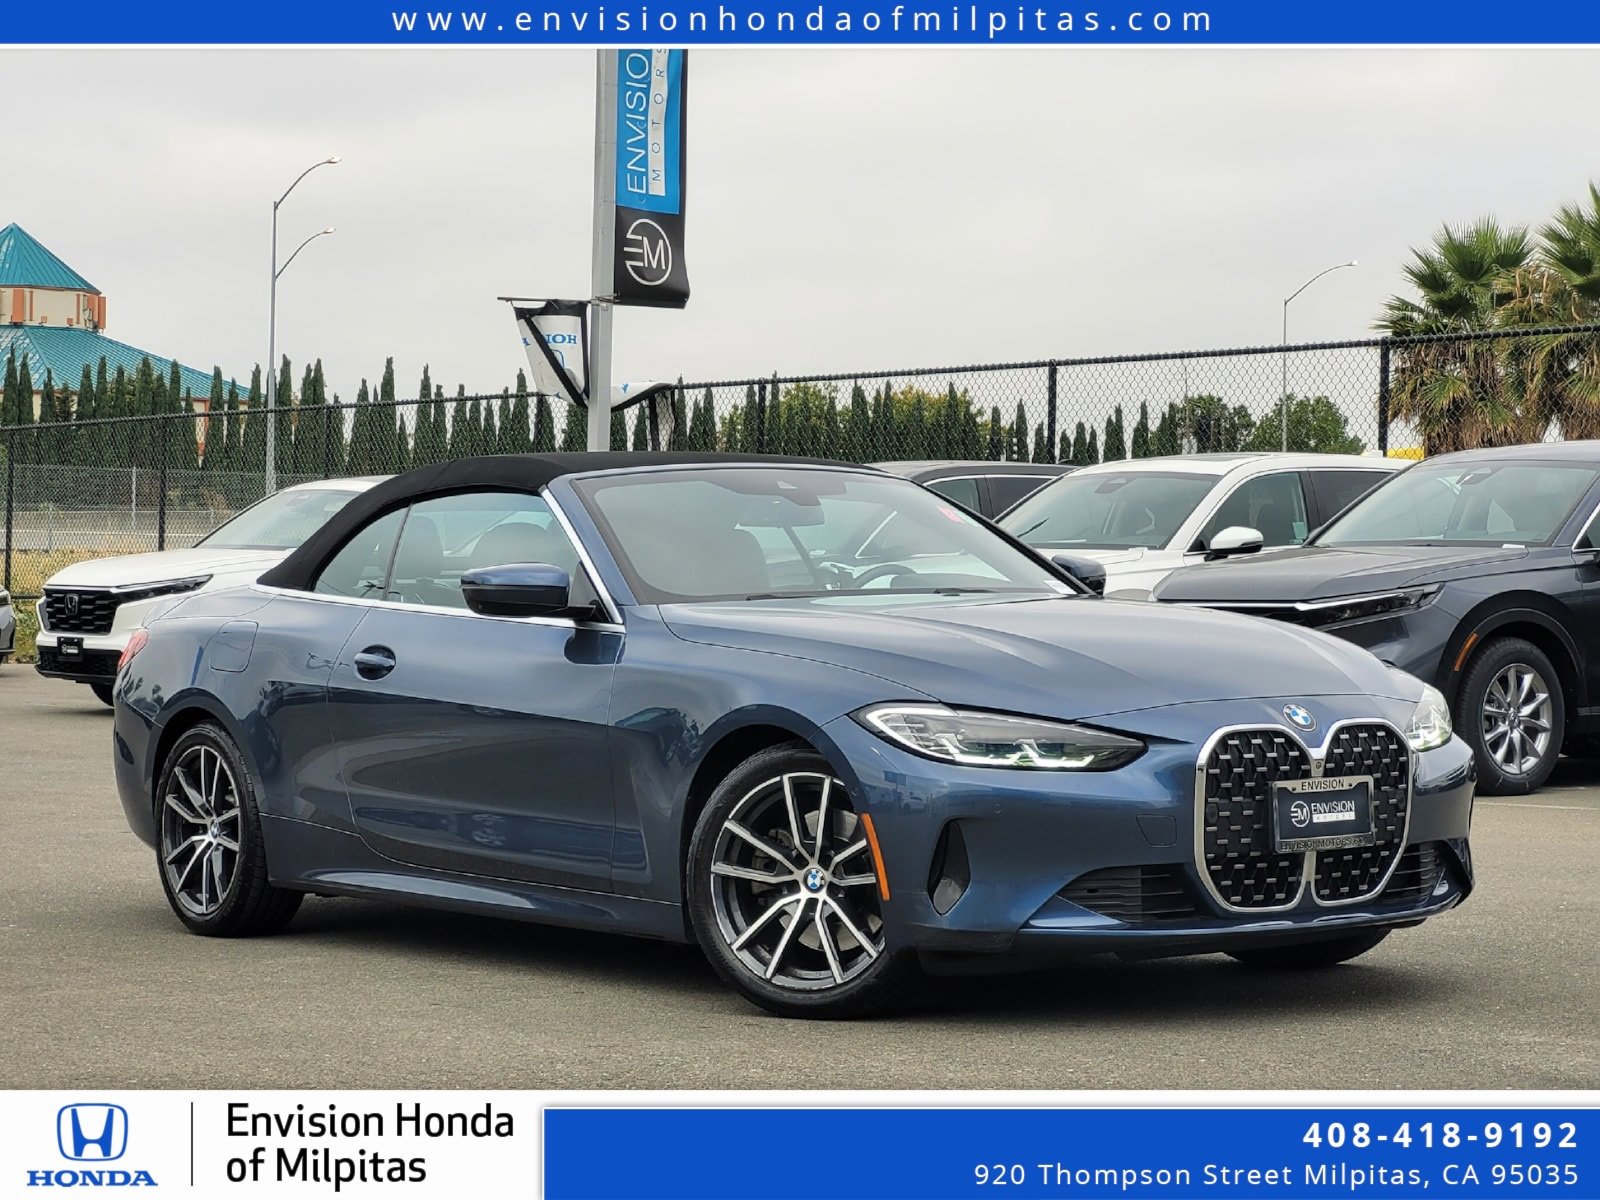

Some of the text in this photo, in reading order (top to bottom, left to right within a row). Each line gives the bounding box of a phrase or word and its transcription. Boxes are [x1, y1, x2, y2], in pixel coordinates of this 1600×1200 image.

[625, 49, 649, 194] ENVISIO
[1301, 779, 1345, 791] ENVISION
[1311, 800, 1355, 815] ENVISION
